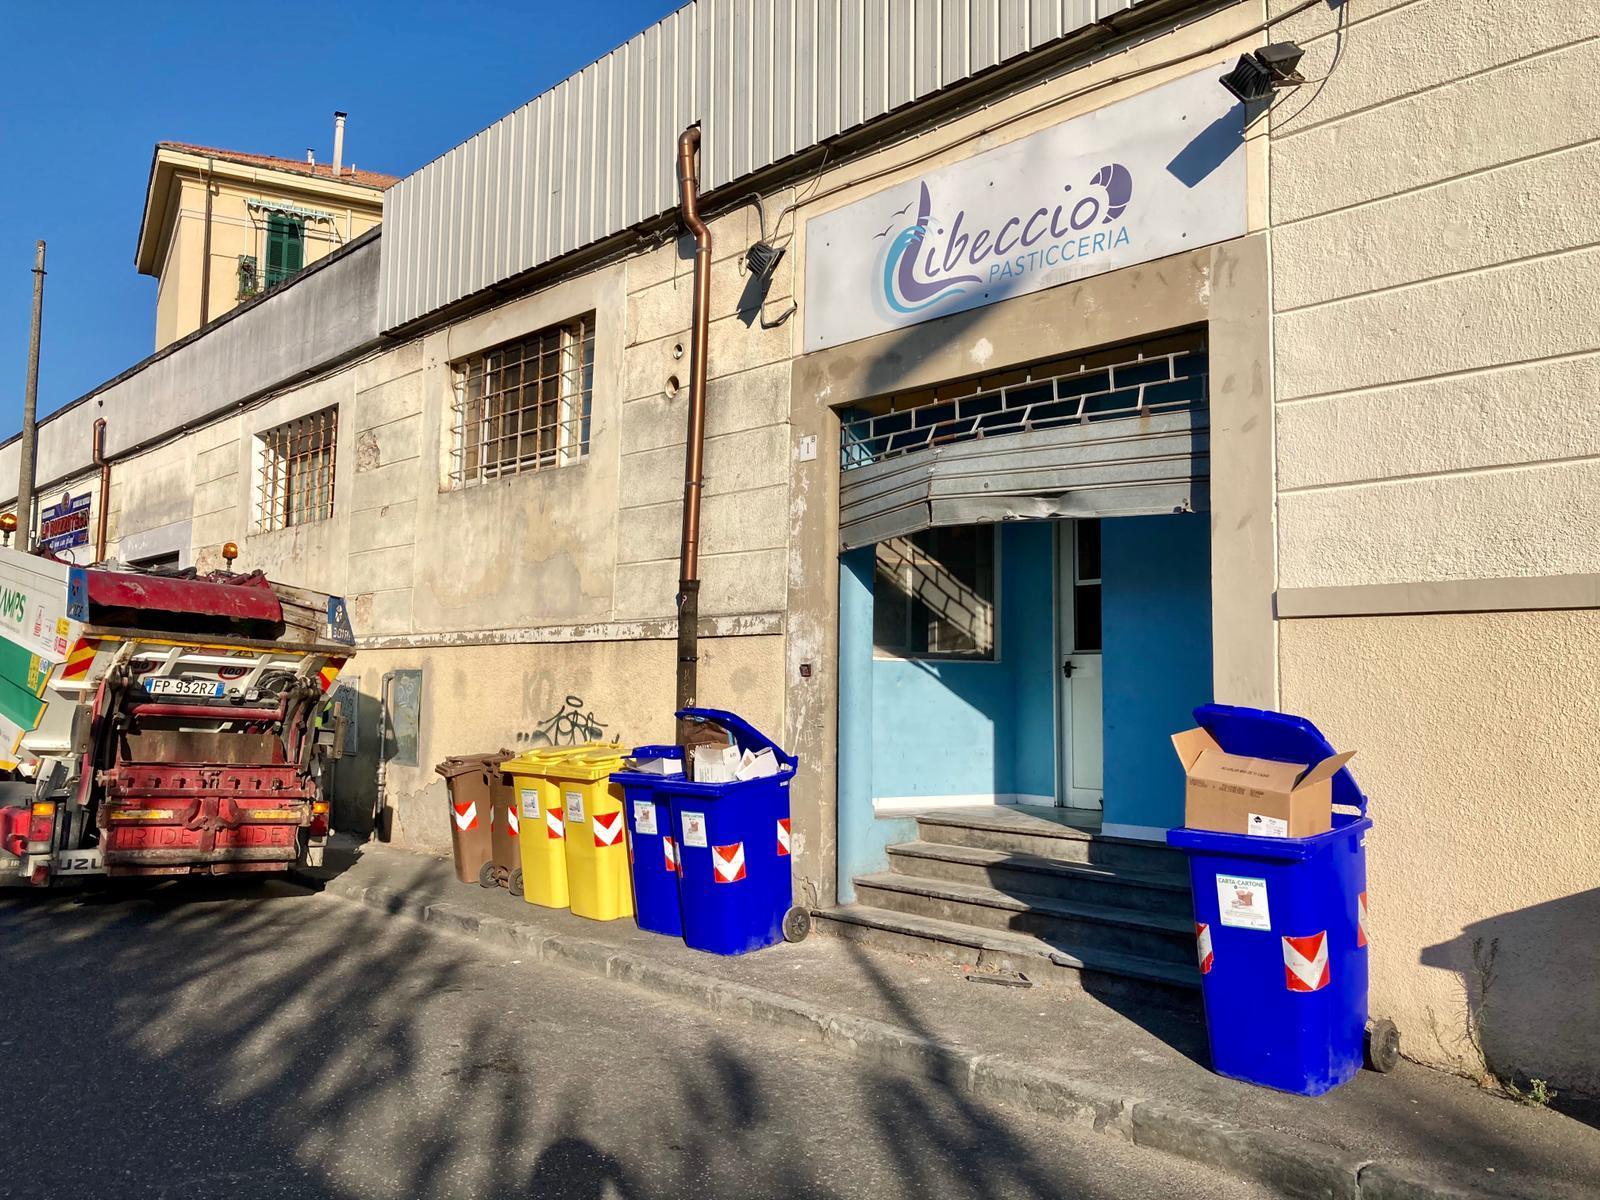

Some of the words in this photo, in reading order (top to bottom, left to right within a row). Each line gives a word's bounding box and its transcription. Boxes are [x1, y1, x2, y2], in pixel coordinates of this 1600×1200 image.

[899, 180, 1100, 302] Libeccio
[989, 226, 1129, 283] PASTICCERIA
[0, 585, 27, 622] AMPS
[223, 667, 242, 676] 100
[153, 680, 171, 692] FP
[175, 682, 216, 695] 932RZ
[1237, 880, 1265, 888] CARTONE
